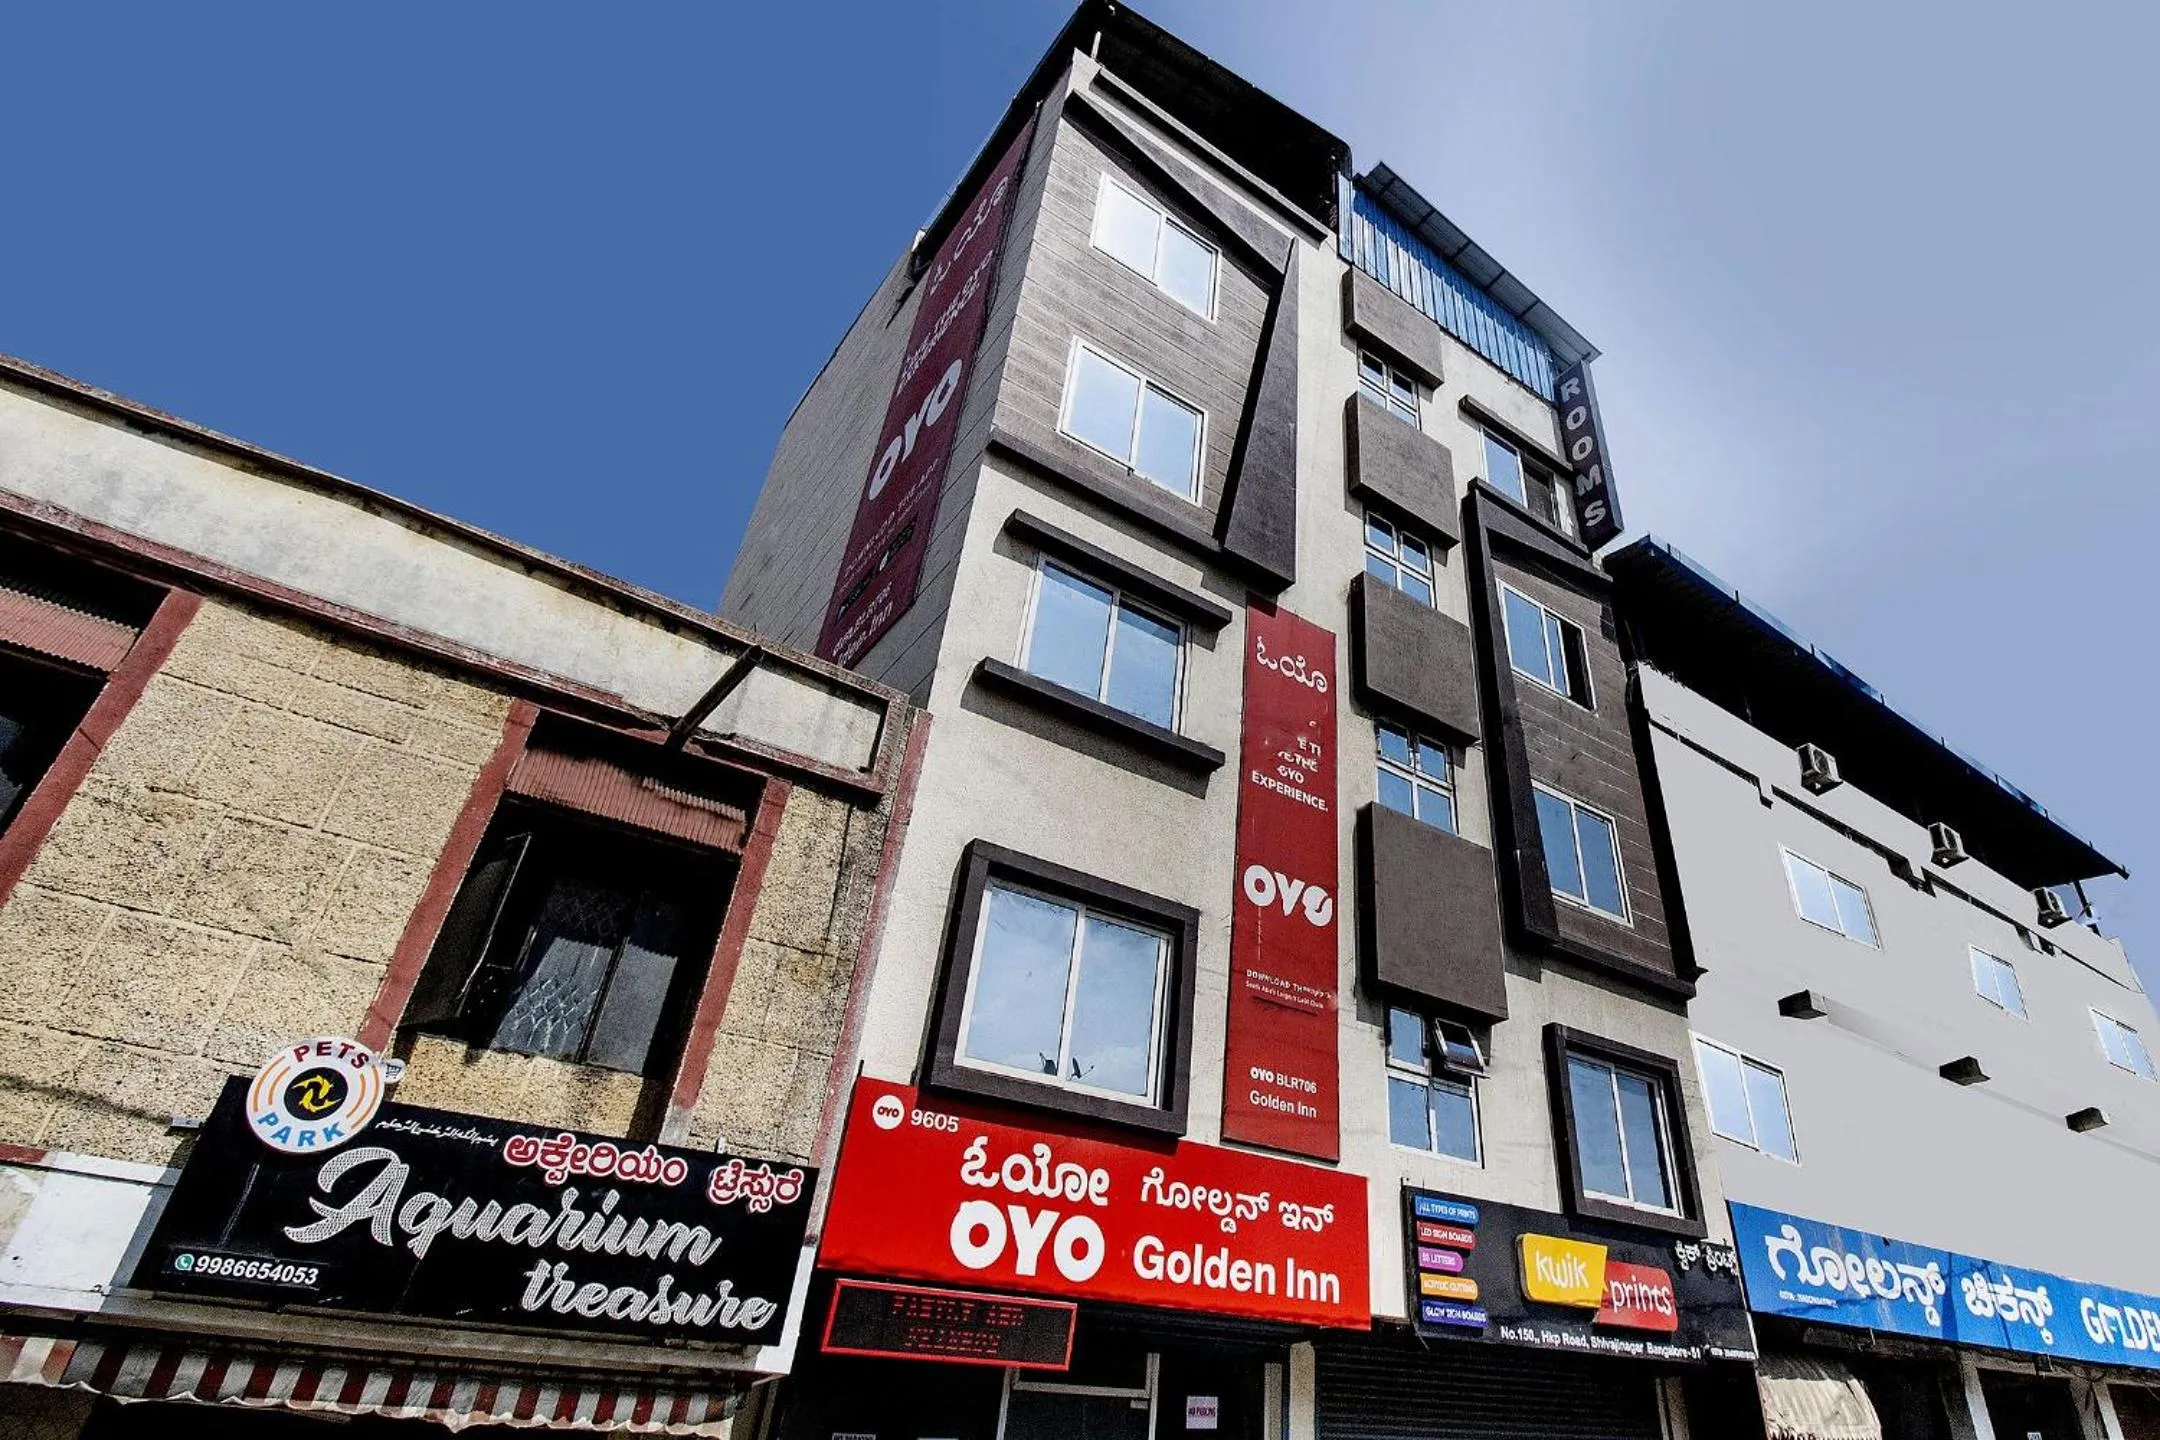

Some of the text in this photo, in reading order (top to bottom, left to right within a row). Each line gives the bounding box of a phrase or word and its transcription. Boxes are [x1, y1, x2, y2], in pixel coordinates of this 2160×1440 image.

[869, 359, 963, 501] OYO
[1560, 376, 1606, 528] ROOMS
[1252, 770, 1329, 812] EXPERIENCE.
[293, 1040, 370, 1070] PETS
[1250, 1066, 1318, 1094] OYO BLR706
[877, 1105, 960, 1133] OYO 9605
[1249, 1089, 1317, 1119] Golden Inn
[256, 1111, 346, 1148] PARK
[960, 1135, 1110, 1207] ಓಯೋ
[1277, 1199, 1335, 1233] ಇನ್
[284, 1146, 723, 1266] Aquarium
[195, 1254, 320, 1286] 9986654053
[949, 1199, 1340, 1305] OYO Golden Inn
[520, 1258, 778, 1330] treasure
[1609, 1274, 1673, 1316] prints
